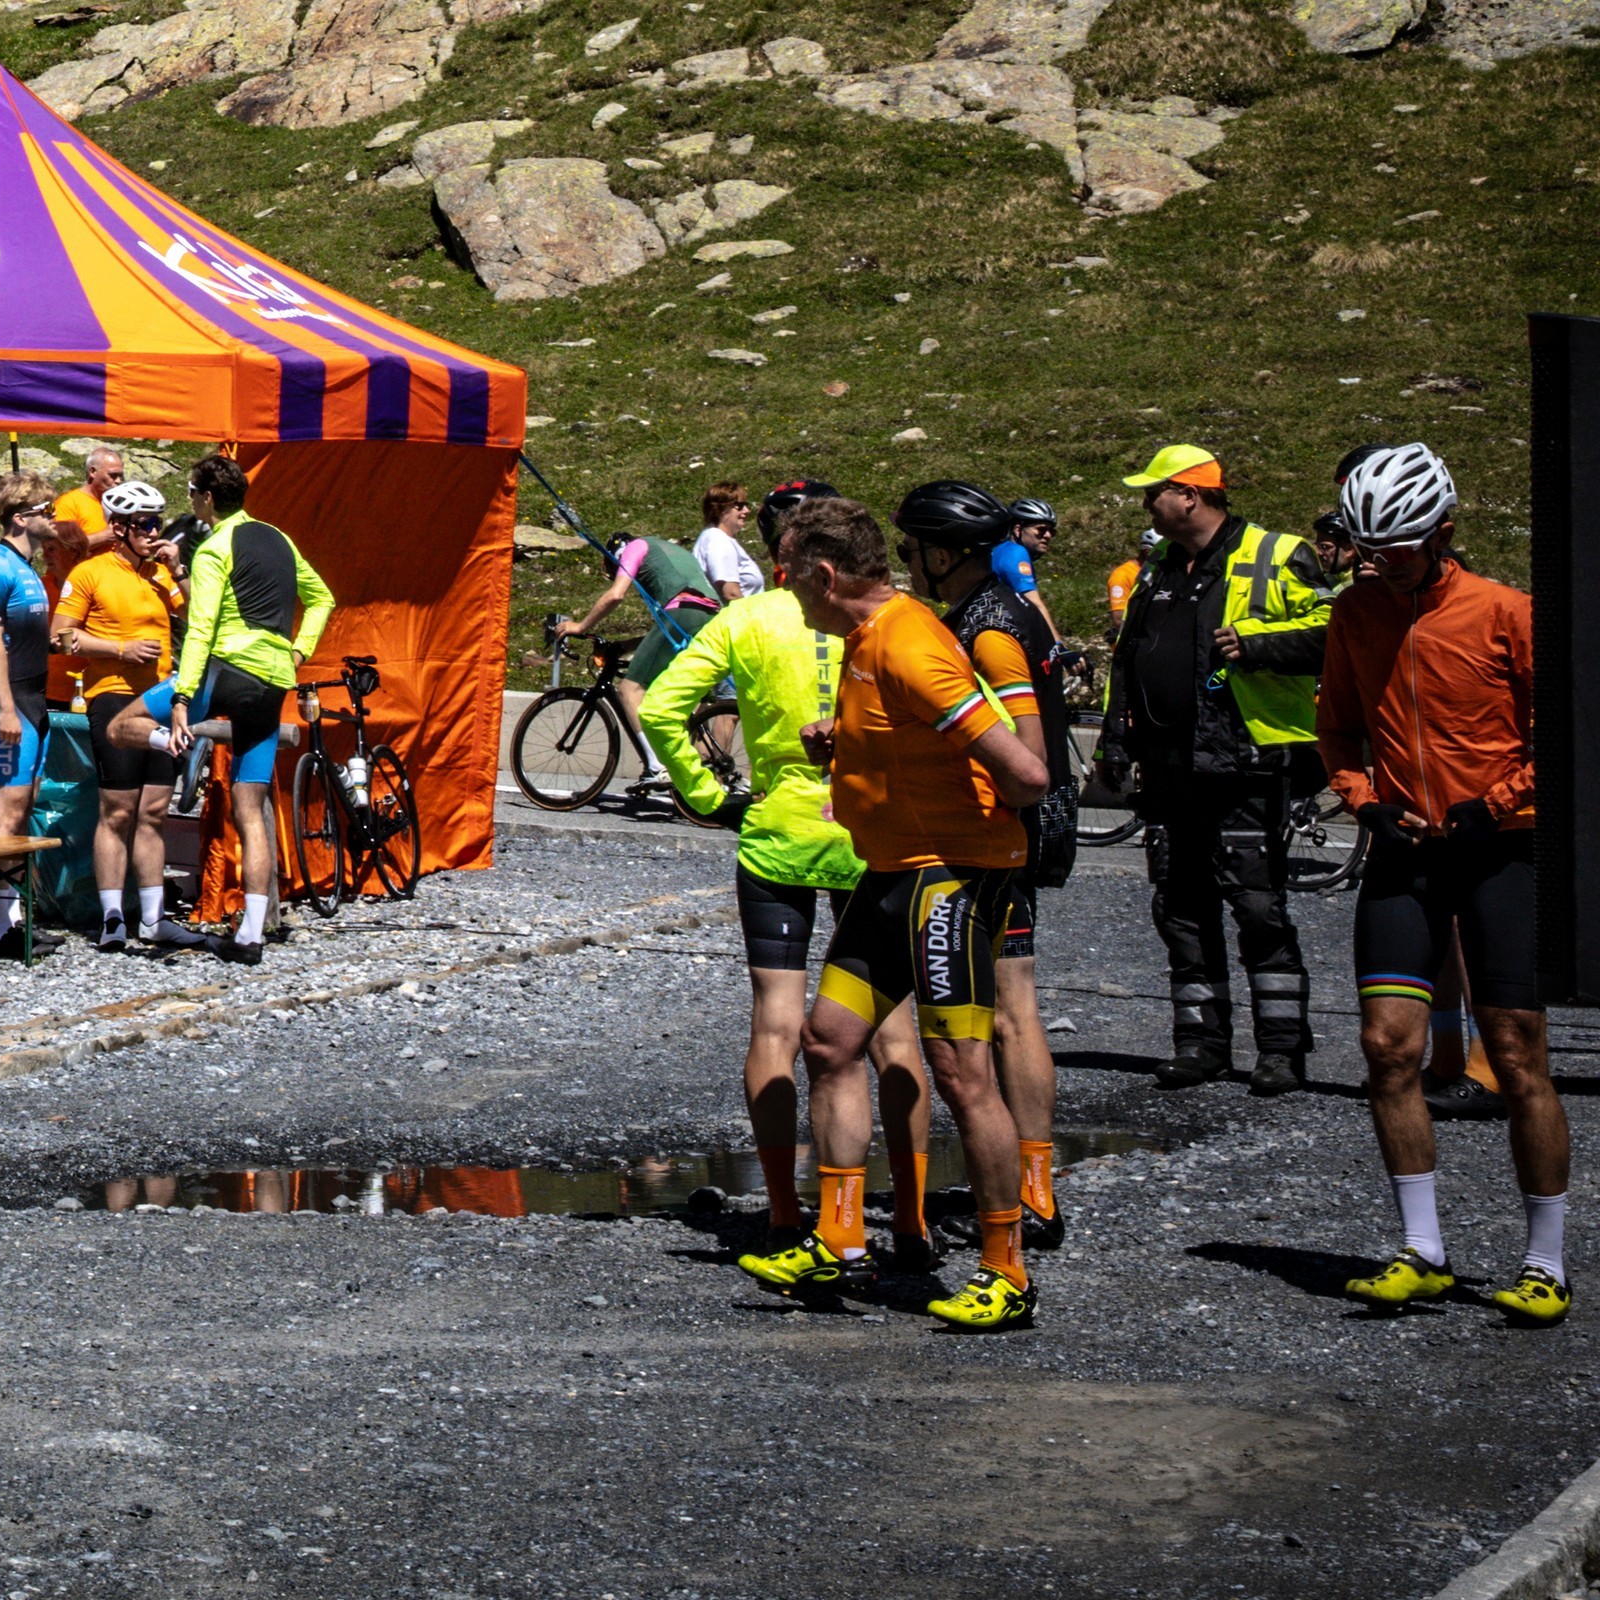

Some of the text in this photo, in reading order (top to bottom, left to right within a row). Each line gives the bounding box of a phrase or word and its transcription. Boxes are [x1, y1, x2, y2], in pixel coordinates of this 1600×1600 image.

[928, 892, 952, 1000] VAN DORP
[953, 898, 967, 952] VOOR MORGEN
